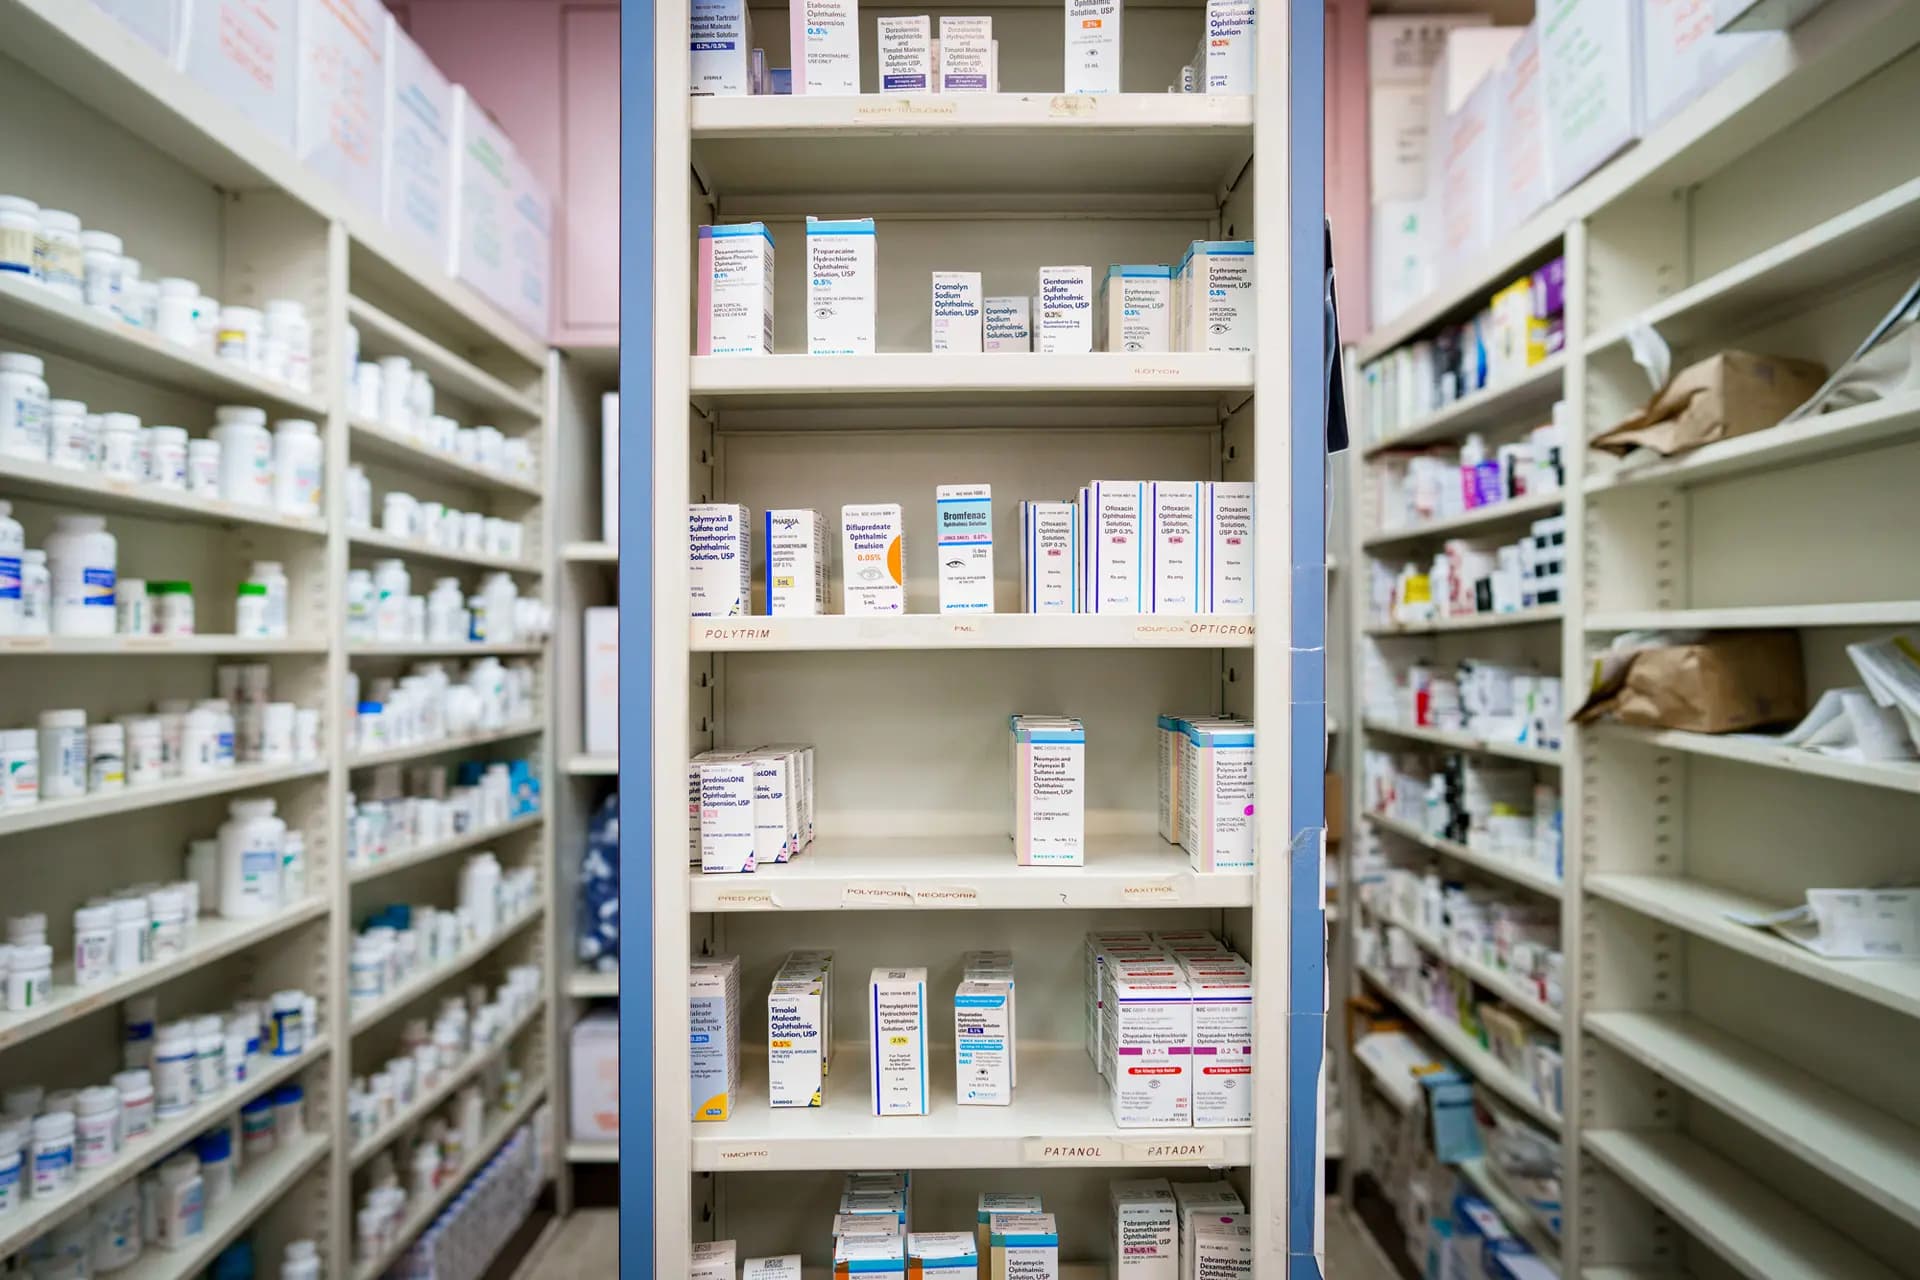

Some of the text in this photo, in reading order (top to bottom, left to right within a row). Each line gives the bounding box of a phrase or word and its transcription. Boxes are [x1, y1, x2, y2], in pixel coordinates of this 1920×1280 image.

[807, 10, 846, 19] Ophthalmic
[807, 19, 845, 27] Suspension
[1211, 18, 1254, 28] Ophthalmic
[1211, 28, 1241, 36] Solution
[935, 283, 968, 291] Cromolyn
[1044, 294, 1083, 302] Ophthalmic
[935, 300, 973, 308] Ophthalmic
[1044, 302, 1074, 310] Solution,
[689, 515, 726, 524] Polymyxin
[944, 512, 986, 520] Bromfenac
[690, 524, 713, 532] Sulfate
[846, 524, 891, 532] Difluprednate
[690, 534, 736, 542] Trimethoprim
[850, 533, 887, 541] Ophthalmic
[690, 544, 730, 552] Ophthalmic
[705, 630, 770, 638] POLYTRIM
[848, 888, 910, 897] POLYSPORIN
[772, 1023, 812, 1031] Ophthalmic
[1044, 1148, 1101, 1156] PATANOL
[1148, 1146, 1205, 1156] PATADAY
[1124, 1220, 1157, 1228] Tobramycin
[1200, 1256, 1237, 1266] Tobramycin
[1200, 1271, 1237, 1279] Ophthalmic
